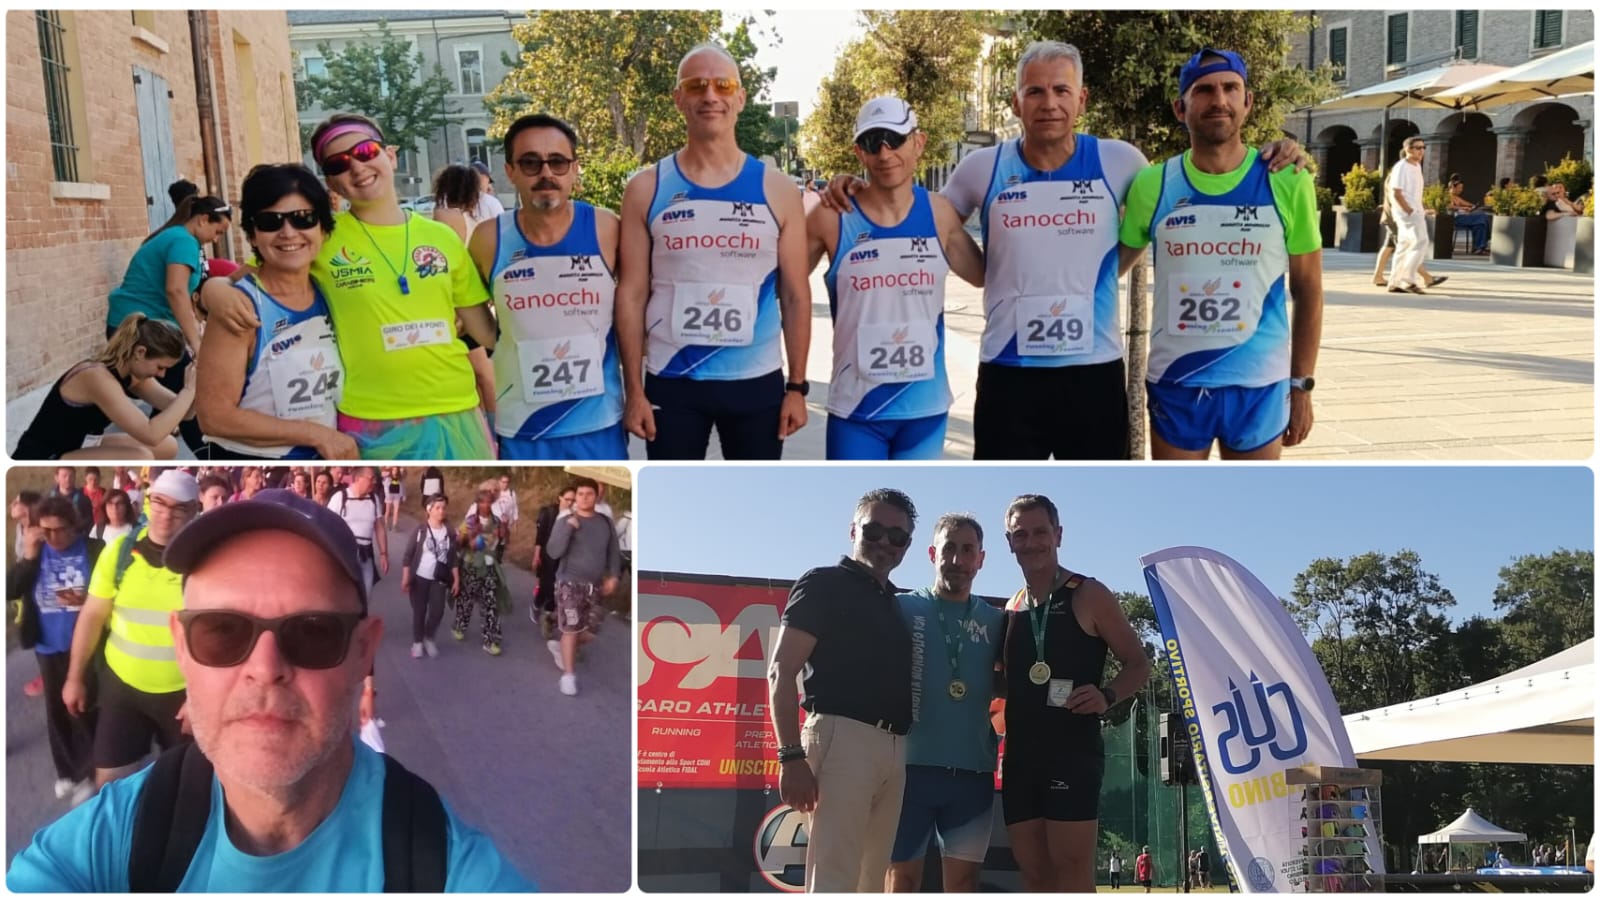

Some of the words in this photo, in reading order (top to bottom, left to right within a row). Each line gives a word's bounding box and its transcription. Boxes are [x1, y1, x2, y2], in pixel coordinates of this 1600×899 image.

[998, 191, 1027, 201] AVIS
[662, 209, 695, 221] AVIS
[1002, 209, 1095, 228] Ranocchi
[1165, 214, 1196, 226] AVIS
[1058, 228, 1094, 236] software
[663, 231, 760, 250] Ranocchi
[1165, 237, 1262, 256] Ranocchi
[720, 250, 757, 258] software
[850, 249, 879, 261] AVIS
[1220, 258, 1258, 266] software
[330, 267, 374, 279] USMIA
[503, 268, 535, 280] AVIS
[850, 268, 935, 291] Ranocchi
[902, 288, 933, 296] software
[504, 287, 600, 311] Ranocchi
[563, 308, 598, 316] software
[1179, 298, 1241, 322] 262
[683, 306, 742, 332] 246
[383, 326, 403, 334] GIRO
[405, 323, 418, 331] DEI
[1027, 318, 1083, 342] 249
[870, 345, 925, 369] 248
[532, 359, 592, 388] 247
[696, 702, 771, 716] ATHLE
[652, 728, 701, 738] RUNNING
[745, 730, 774, 739] PREP.
[679, 759, 696, 767] Sport
